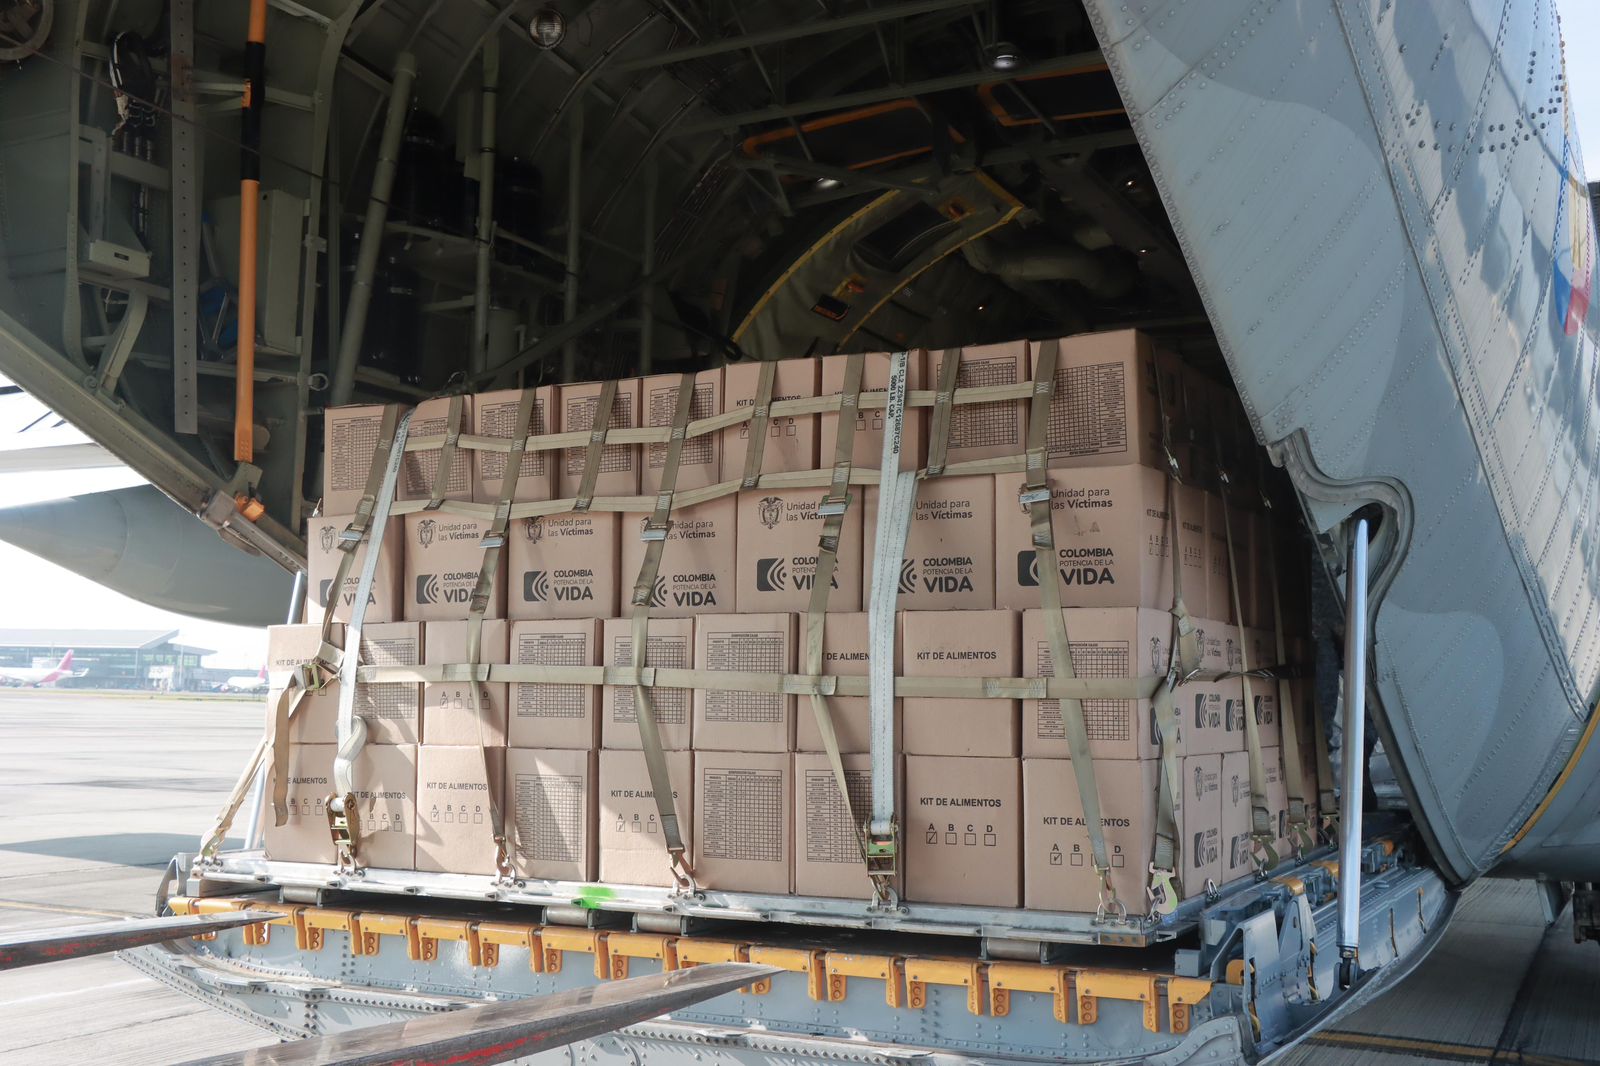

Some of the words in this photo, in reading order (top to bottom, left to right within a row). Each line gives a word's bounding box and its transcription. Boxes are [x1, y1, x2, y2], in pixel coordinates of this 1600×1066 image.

[890, 375, 898, 390] 5000
[736, 399, 748, 407] KIT
[742, 420, 748, 428] A
[788, 417, 794, 425] D
[1051, 487, 1085, 499] Unidad
[1088, 488, 1110, 499] para
[786, 500, 816, 511] Unidad
[916, 499, 948, 510] Unidad
[950, 500, 970, 510] para
[1051, 499, 1065, 510] las
[1067, 498, 1113, 509] Víctimas
[786, 512, 799, 521] las
[915, 511, 929, 521] las
[931, 510, 973, 520] Víctimas
[439, 523, 461, 532] Unidad
[462, 523, 478, 531] para
[547, 517, 574, 528] Unidad
[575, 518, 592, 527] para
[672, 519, 694, 530] nidad
[695, 520, 714, 530] para
[438, 533, 448, 541] las
[449, 531, 480, 541] Víctimas
[547, 528, 559, 537] las
[560, 527, 594, 537] Víctimas
[679, 529, 716, 540] Víctimas
[1059, 547, 1114, 558] COLOMBIA
[923, 556, 973, 567] COLOMBIA
[1059, 559, 1094, 567] POTENCIA
[442, 571, 479, 581] COLOMBIA
[553, 569, 594, 578] COLOMBIA
[673, 573, 717, 583] COLOMBIA
[1060, 567, 1115, 586] VIDA
[673, 583, 700, 591] POTENCIA
[923, 576, 974, 593] VIDA
[554, 585, 594, 601] VIDA
[343, 591, 377, 606] VIA
[673, 590, 717, 607] VIDA
[826, 652, 838, 661] DE
[839, 652, 871, 661] ALIMEN
[917, 651, 931, 660] KIT
[932, 651, 945, 660] DE
[946, 651, 998, 660] ALIMENTOS
[483, 690, 489, 698] D
[292, 777, 328, 785] ALIMENTOS
[438, 782, 448, 790] DE
[448, 782, 488, 791] ALIMENTOS
[360, 791, 369, 799] DE
[370, 791, 406, 800] ALIMENTOS
[610, 790, 622, 798] KIT
[624, 790, 634, 798] DE
[635, 790, 679, 799] ALIMS
[920, 797, 934, 806] KIT
[936, 797, 948, 806] DE
[949, 798, 1002, 808] ALIMENTOS
[475, 805, 481, 813] D
[633, 813, 640, 821] B
[649, 814, 655, 822] C
[1043, 817, 1058, 826] KIT
[1060, 817, 1073, 826] DE
[1075, 817, 1130, 827] ALENTOS
[928, 823, 935, 831] A
[947, 823, 955, 832] B
[966, 824, 974, 832] C
[986, 824, 993, 833] D
[1052, 844, 1059, 852] A
[1073, 844, 1081, 853] B
[1114, 845, 1121, 854] D
